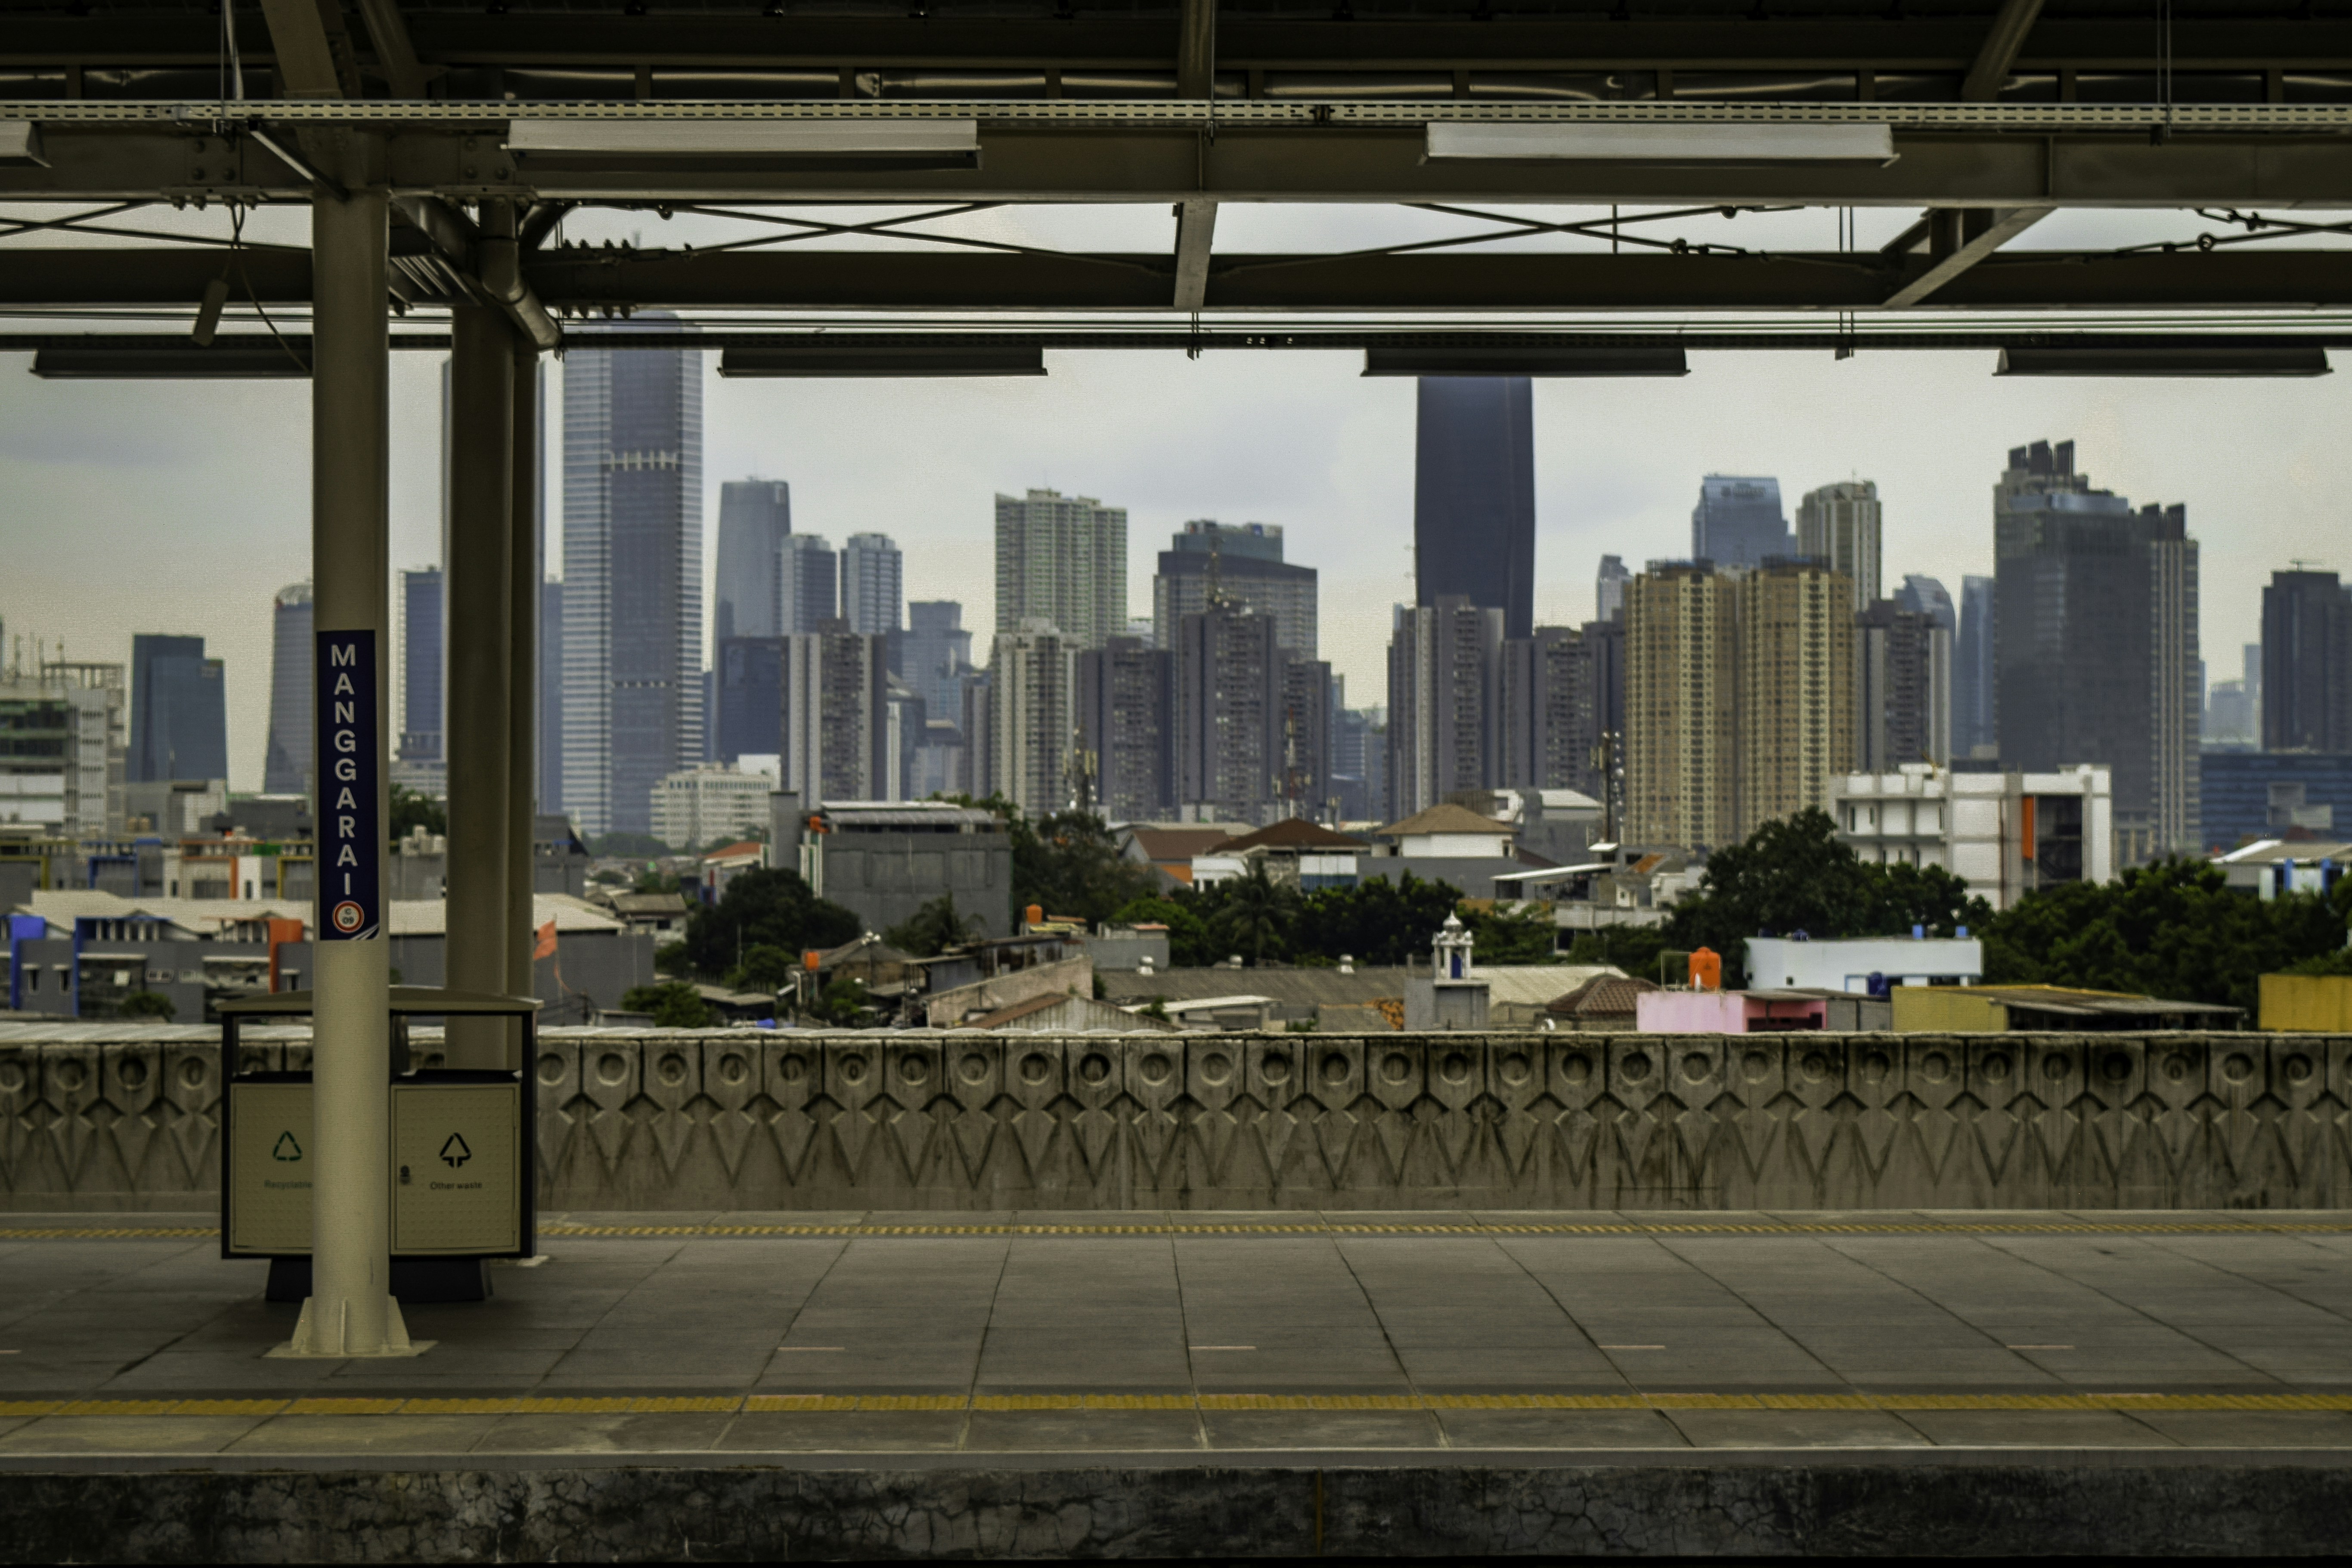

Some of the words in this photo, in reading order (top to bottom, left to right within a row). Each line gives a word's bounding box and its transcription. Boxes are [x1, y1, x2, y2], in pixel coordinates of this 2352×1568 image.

[331, 644, 357, 895] MANGGARAI
[264, 1180, 313, 1190] Recyclable
[430, 1181, 454, 1190] Other
